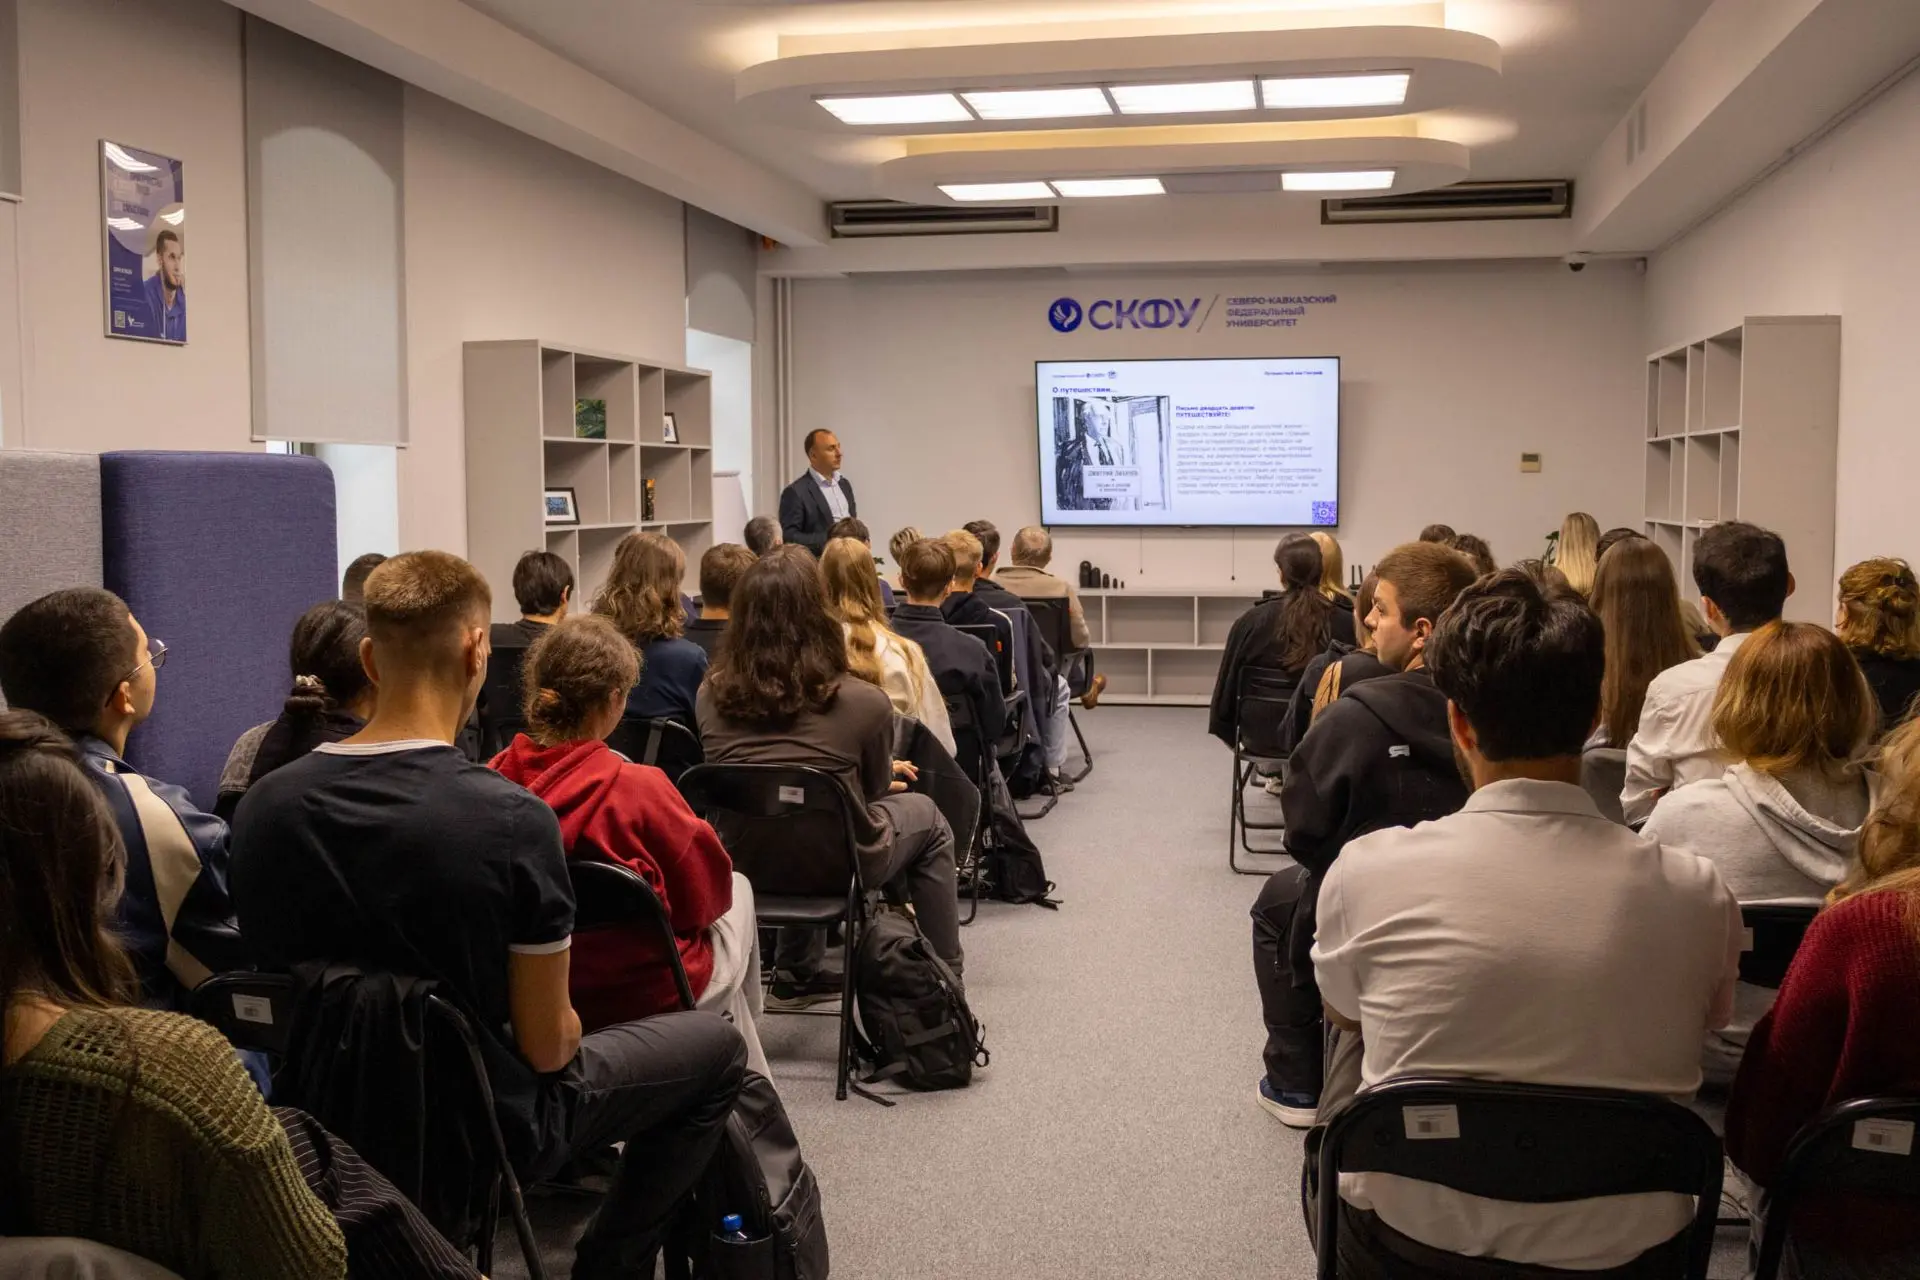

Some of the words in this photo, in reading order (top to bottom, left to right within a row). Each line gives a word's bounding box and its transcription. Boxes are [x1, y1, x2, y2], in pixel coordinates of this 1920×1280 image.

[1226, 294, 1337, 306] СЕВЕРО-КАВКАЗСКИЙ
[1088, 298, 1201, 330] СКФУ
[1226, 305, 1305, 317] ФЕДЕРАЛЬНЫЙ
[1225, 318, 1298, 327] УНИВЕРСИТЕТ
